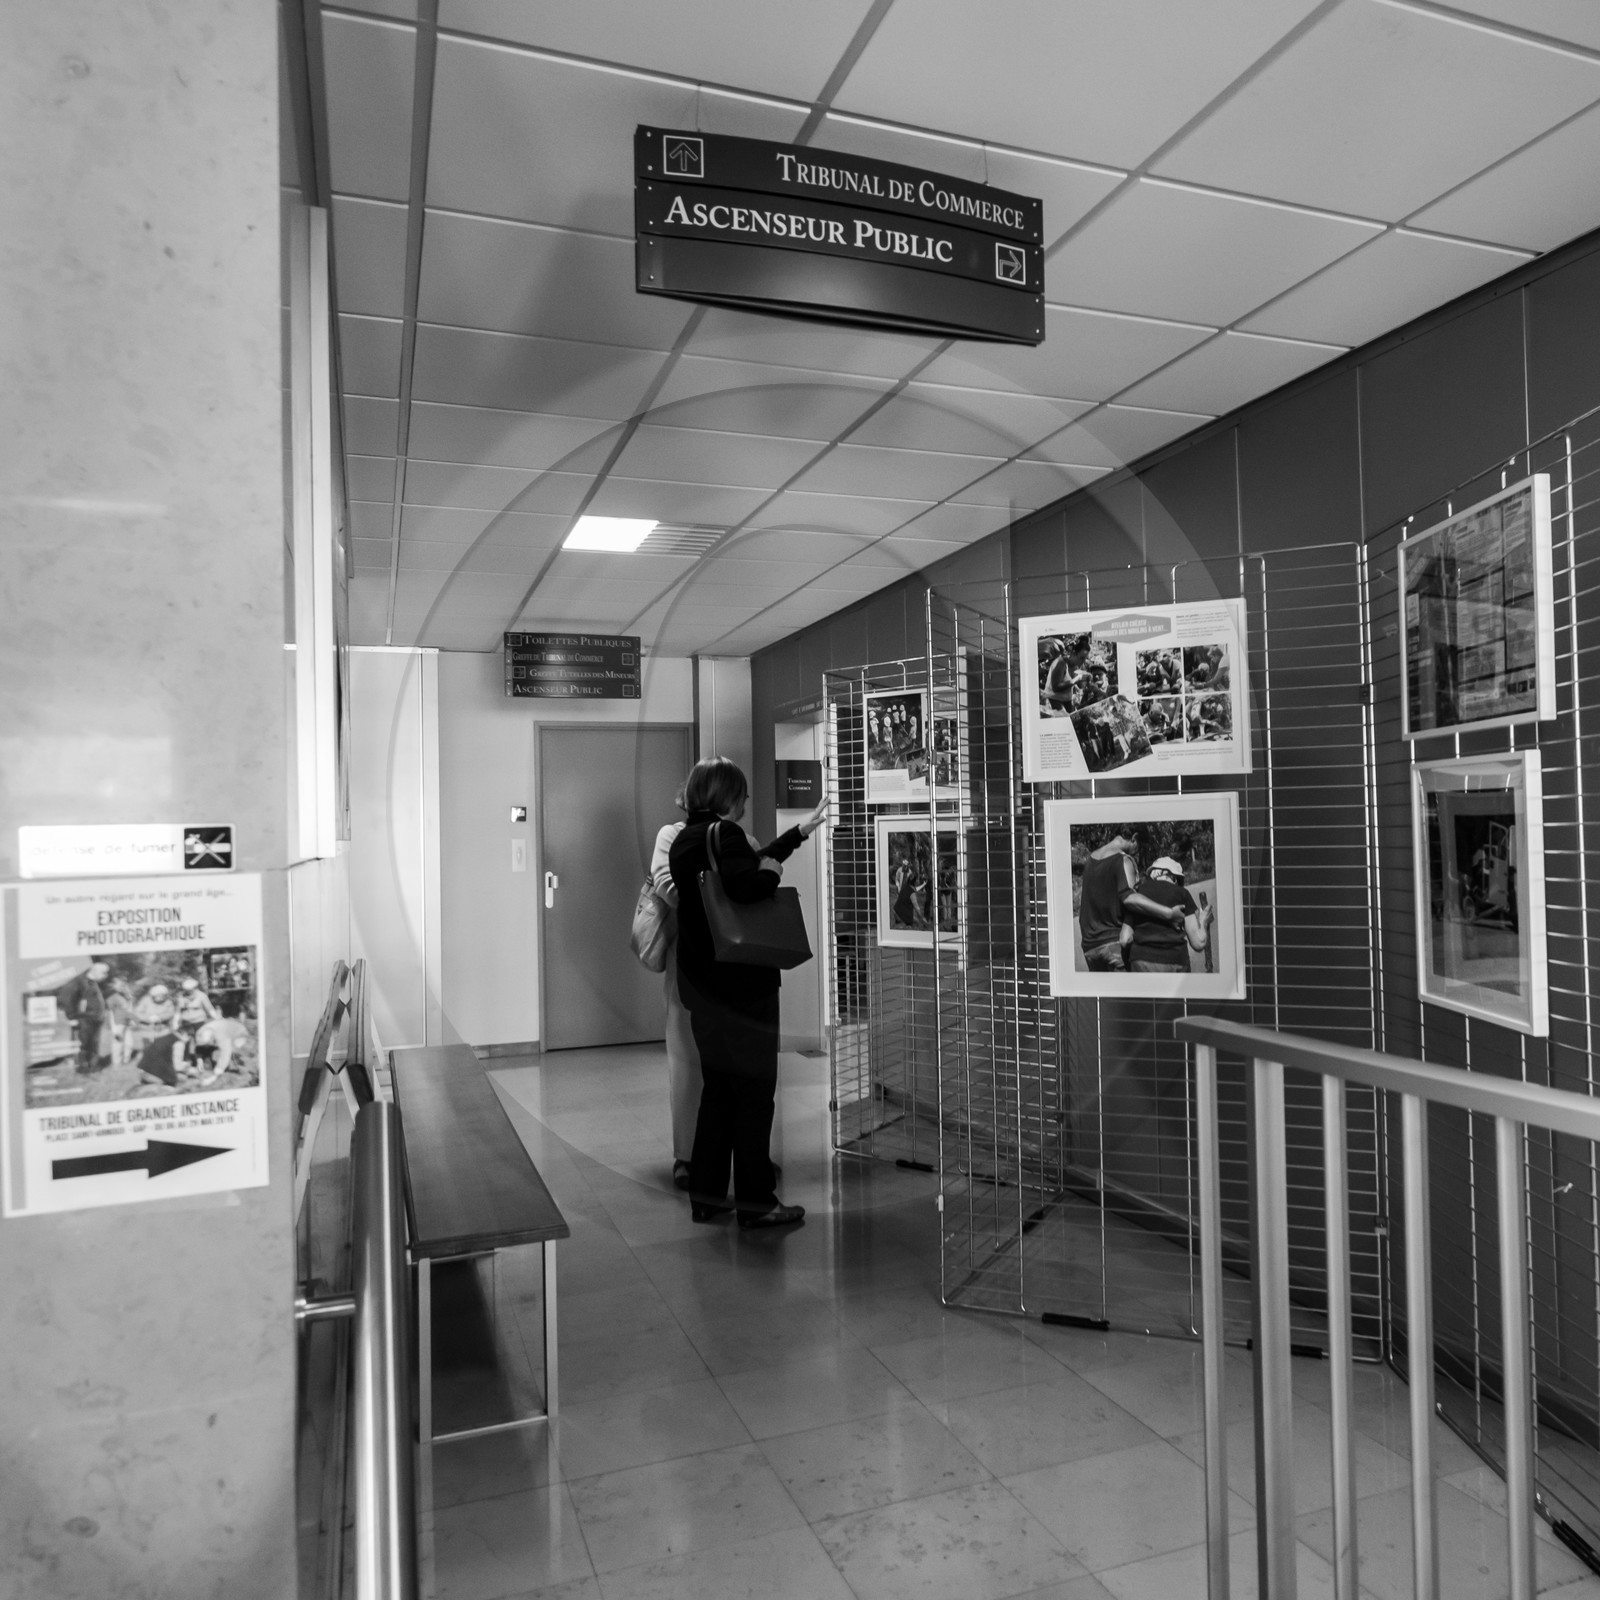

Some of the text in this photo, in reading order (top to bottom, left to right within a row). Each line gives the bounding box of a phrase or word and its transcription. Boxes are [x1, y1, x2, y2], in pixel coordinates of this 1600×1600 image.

[776, 153, 1025, 230] TRIBUNAL DE COMMERCE
[664, 195, 954, 263] ASCENSEUR PUBLIC
[522, 634, 632, 648] TOILETTES PUBLIQUES
[514, 684, 604, 695] ASCENSEUR PUBLIC
[65, 894, 95, 904] autre
[99, 893, 135, 904] regard
[138, 892, 155, 900] sur
[171, 889, 202, 900] grand
[97, 907, 182, 927] EXPOSITION
[77, 924, 206, 946] PHOTOGRAPHIQUE
[38, 1098, 240, 1132] TRIBUNAL DE GRANDE INSTANCE
